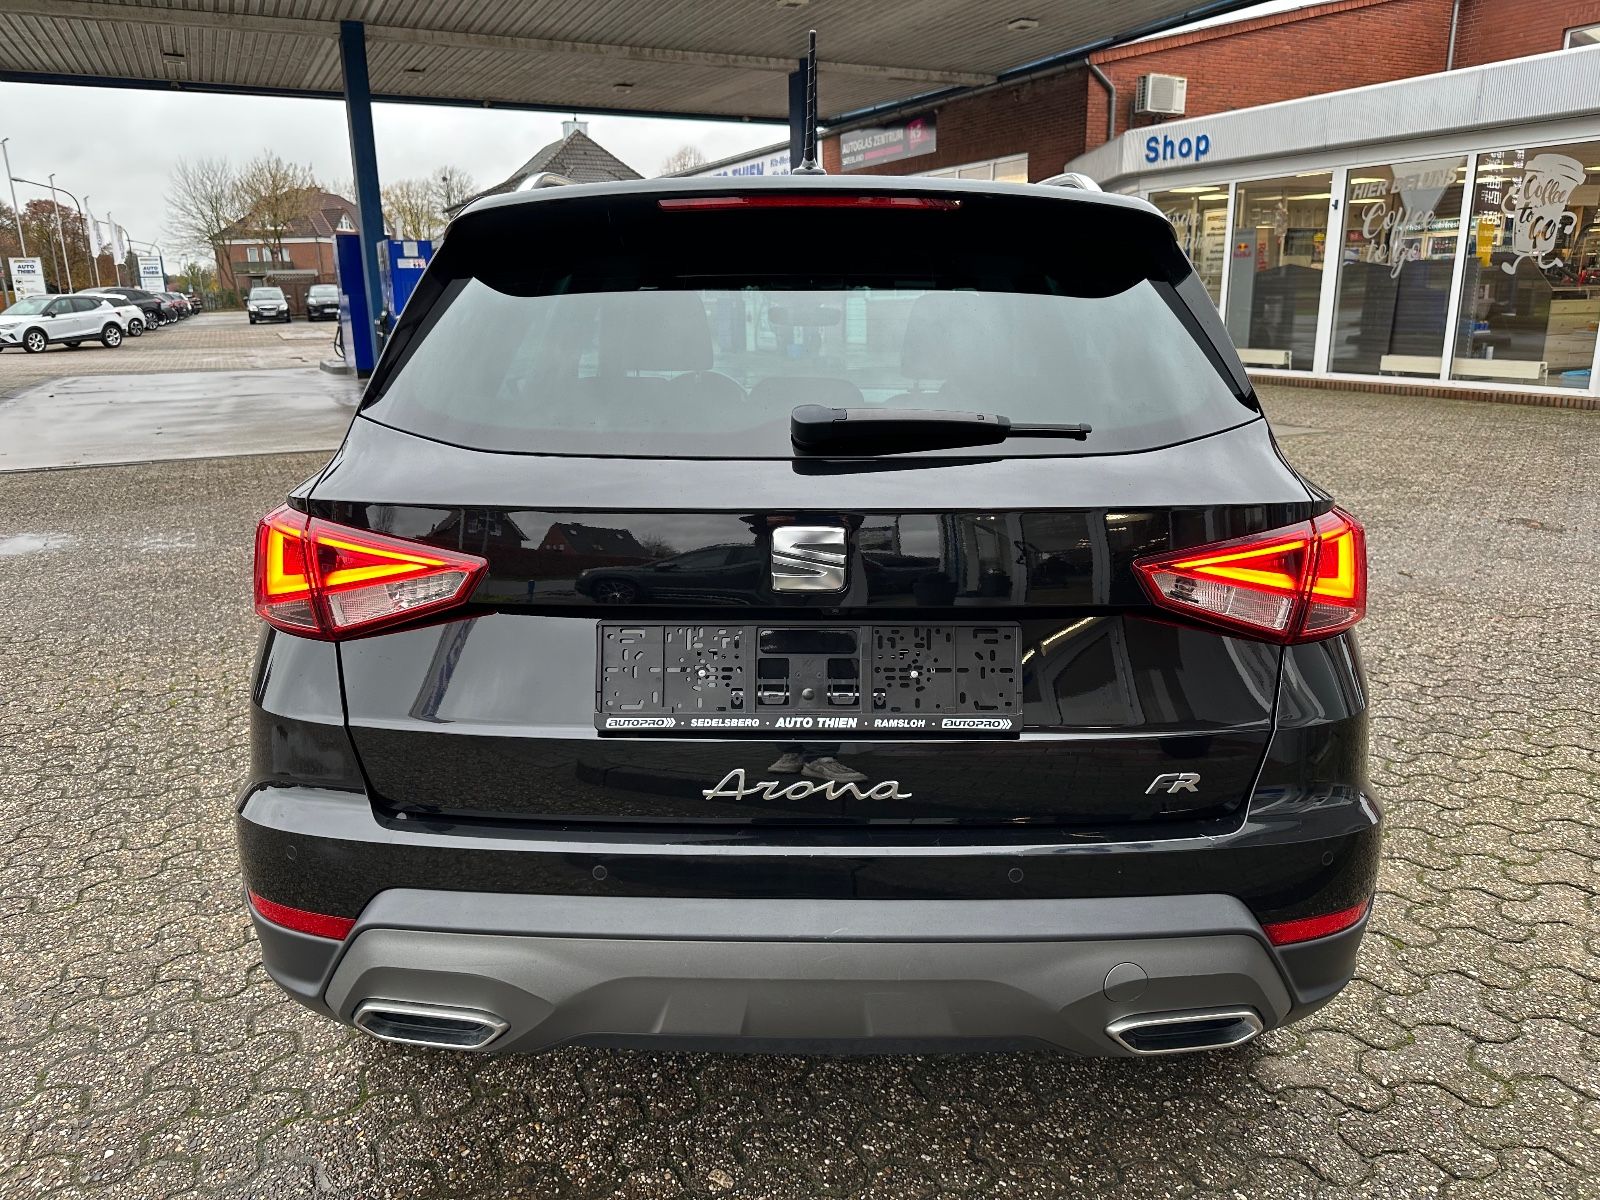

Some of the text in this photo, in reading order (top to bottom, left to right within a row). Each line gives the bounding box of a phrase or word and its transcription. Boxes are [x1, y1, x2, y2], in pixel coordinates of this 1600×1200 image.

[842, 129, 904, 154] AUTOGLAS ZENTRUM
[1145, 134, 1210, 163] Shop
[1352, 168, 1457, 200] HIER BEI UNS
[1523, 174, 1567, 206] Coffee
[1362, 202, 1436, 250] Coffee
[1517, 202, 1534, 224] to
[1366, 239, 1420, 278] to go
[690, 718, 759, 727] SEDELSBERG
[775, 717, 813, 728] AUTO
[817, 717, 857, 728] THIEN
[874, 719, 926, 728] RAMSLOH
[702, 768, 912, 800] Arona
[1145, 772, 1200, 794] FR
